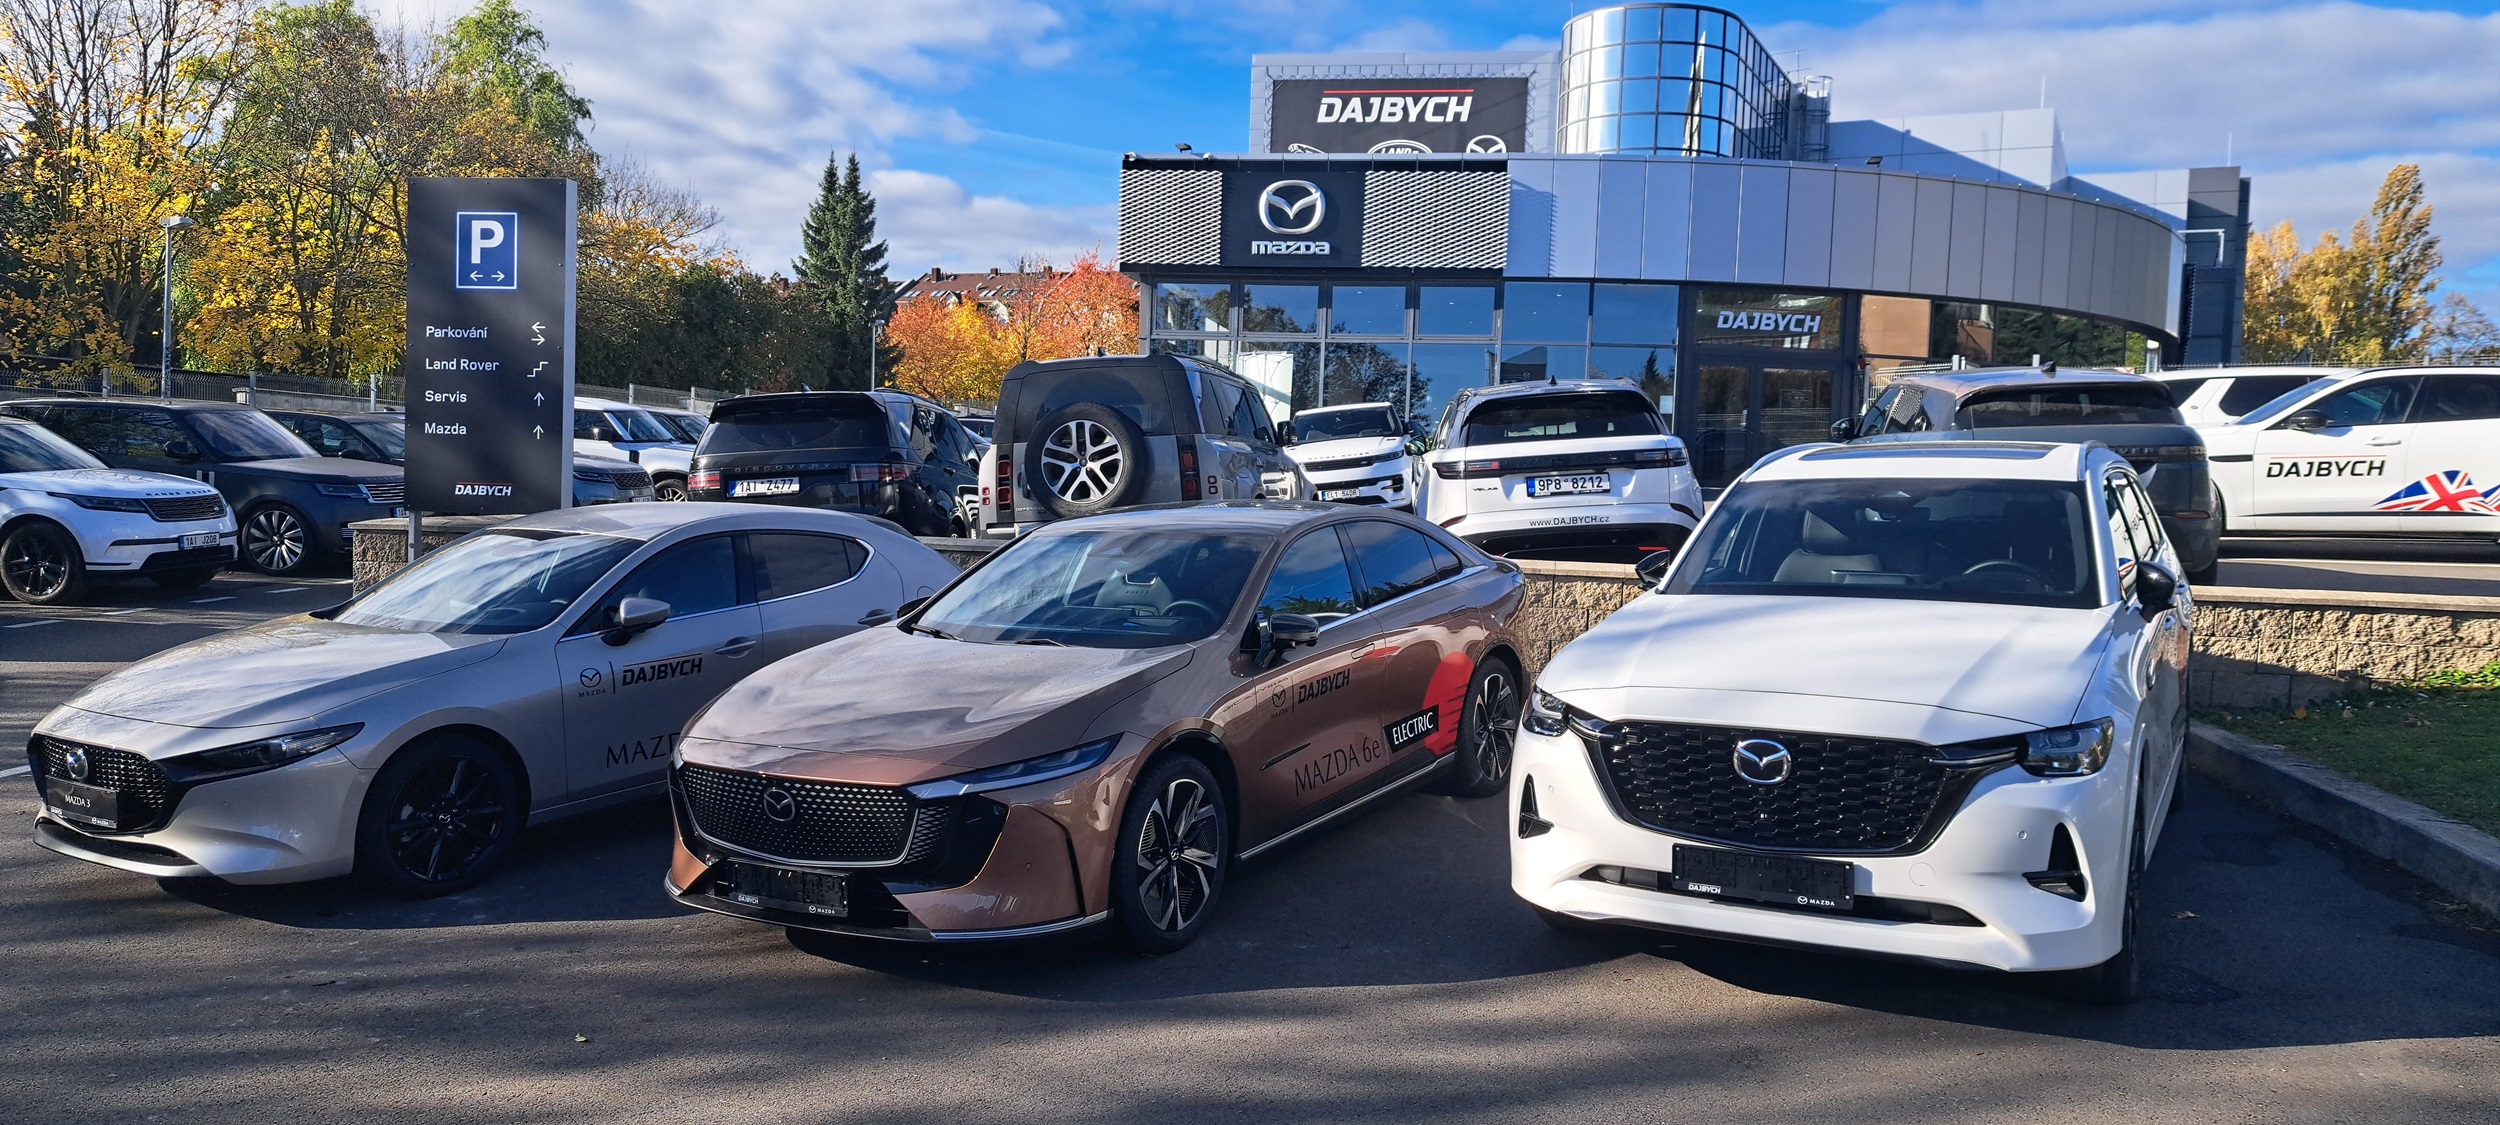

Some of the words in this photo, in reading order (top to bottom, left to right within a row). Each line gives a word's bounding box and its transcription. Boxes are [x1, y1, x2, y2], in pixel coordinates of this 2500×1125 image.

[1317, 96, 1473, 123] DAJBYCH
[471, 220, 504, 264] P
[1717, 310, 1821, 333] DAJBYCH
[425, 325, 488, 339] Parkování
[425, 358, 458, 371] Land
[460, 358, 500, 371] Rover
[425, 390, 467, 403] Servis
[424, 422, 467, 435] Mazda
[735, 463, 831, 473] DISCOVERY
[2266, 460, 2387, 478] DAJBYCH
[455, 484, 512, 497] DAJBYCH
[766, 479, 794, 490] Z477
[1538, 478, 1562, 491] 9P8
[1571, 476, 1604, 489] 8212
[1529, 515, 1610, 527] www.DAJBYCH.cz
[622, 657, 703, 687] DAJBYCH
[578, 688, 607, 698] MAZDA
[1298, 668, 1351, 705] DAJBYCH
[1392, 711, 1434, 746] ELECTRIC
[1294, 744, 1361, 797] MAZDA
[1363, 737, 1382, 764] 6e
[65, 794, 86, 806] MAZDA
[86, 799, 91, 808] 3
[1688, 883, 1721, 894] DAJBYCH
[1809, 898, 1835, 907] MAZDA
